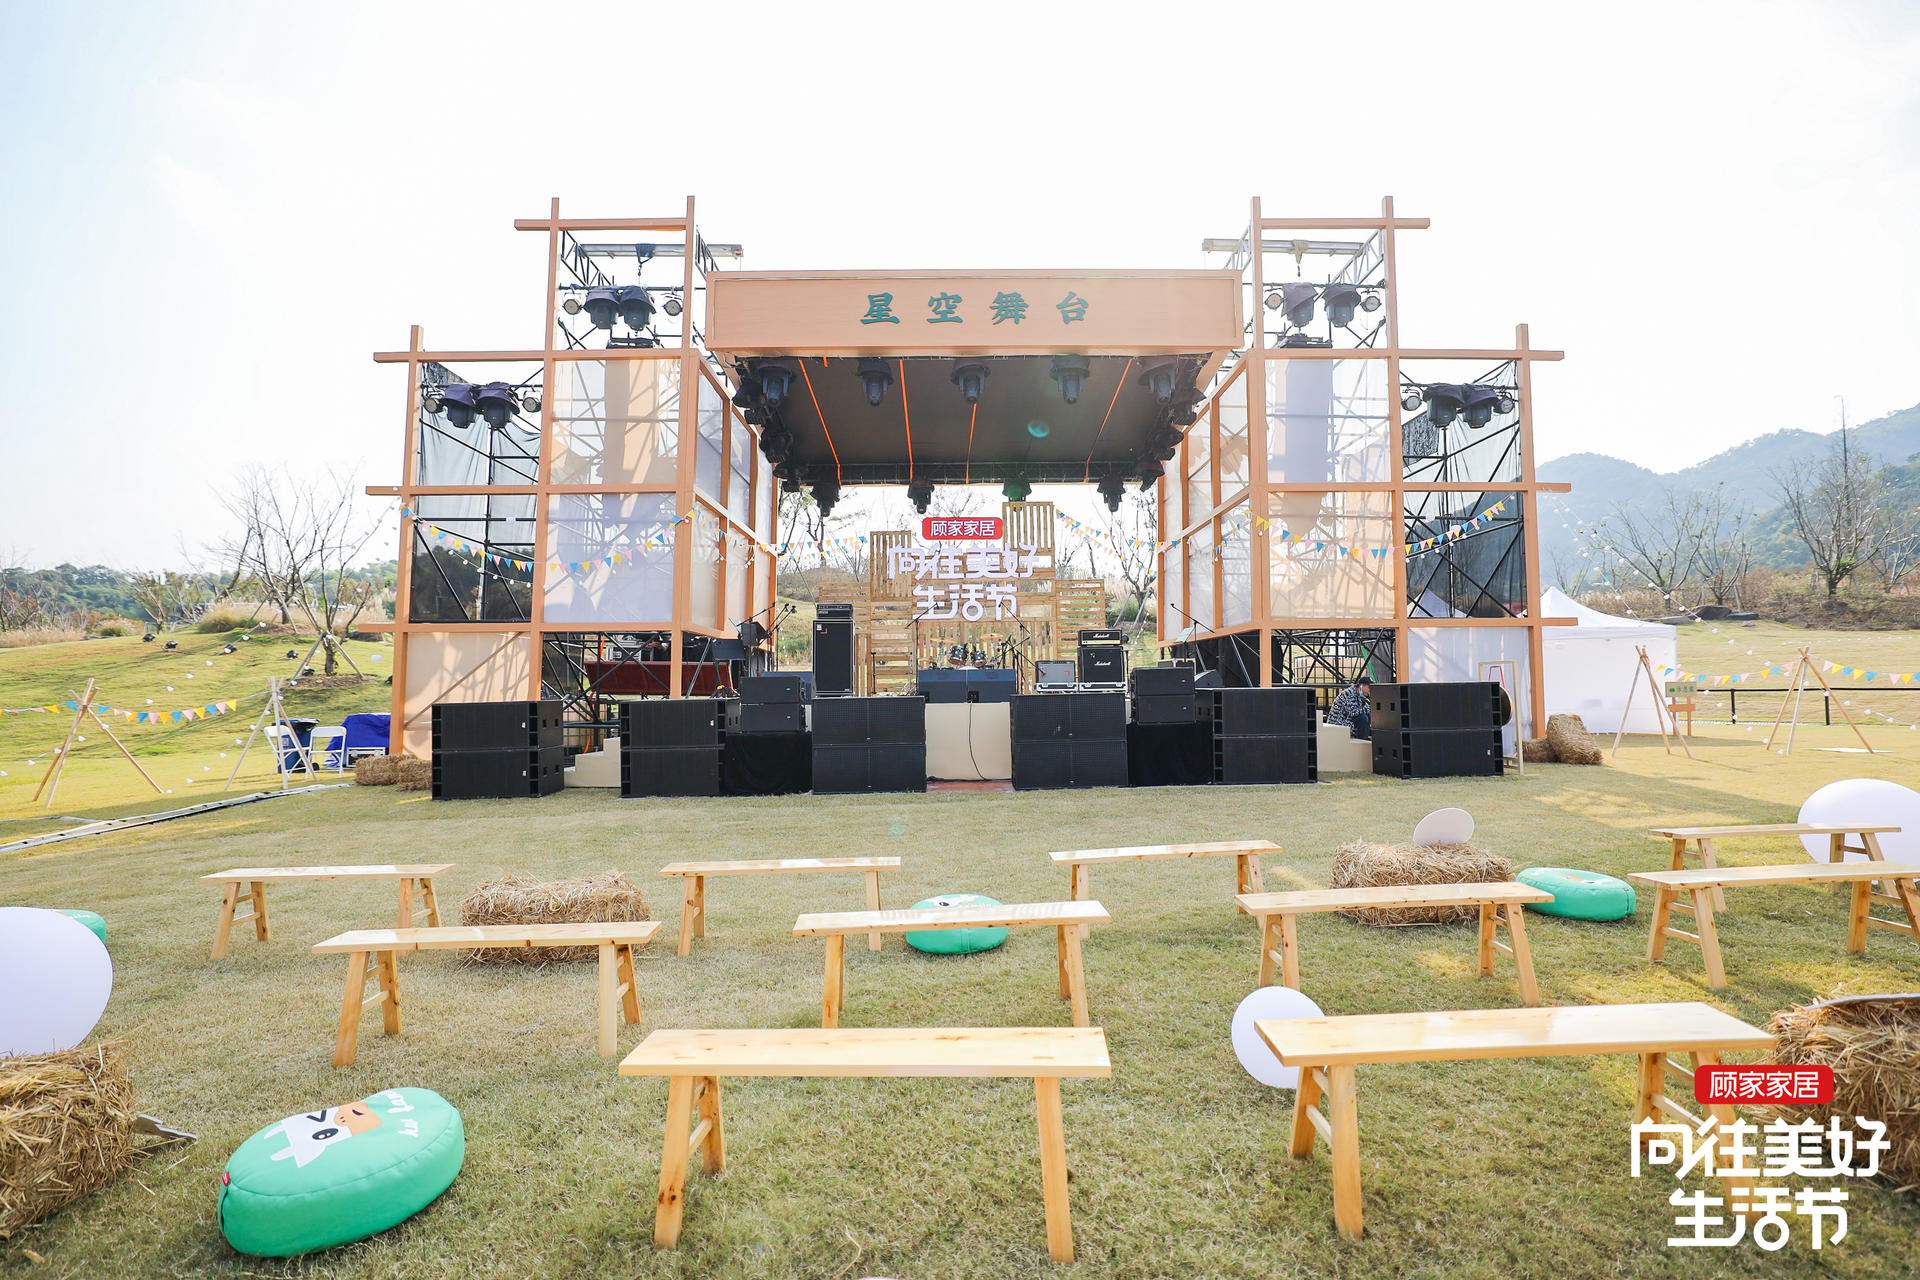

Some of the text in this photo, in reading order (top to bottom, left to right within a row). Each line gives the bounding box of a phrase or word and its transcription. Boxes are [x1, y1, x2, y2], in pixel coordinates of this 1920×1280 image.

[860, 292, 1089, 325] 星空舞台
[930, 520, 996, 538] 顾家家居
[889, 543, 1039, 580] 向往美好
[912, 584, 1018, 622] 生活节
